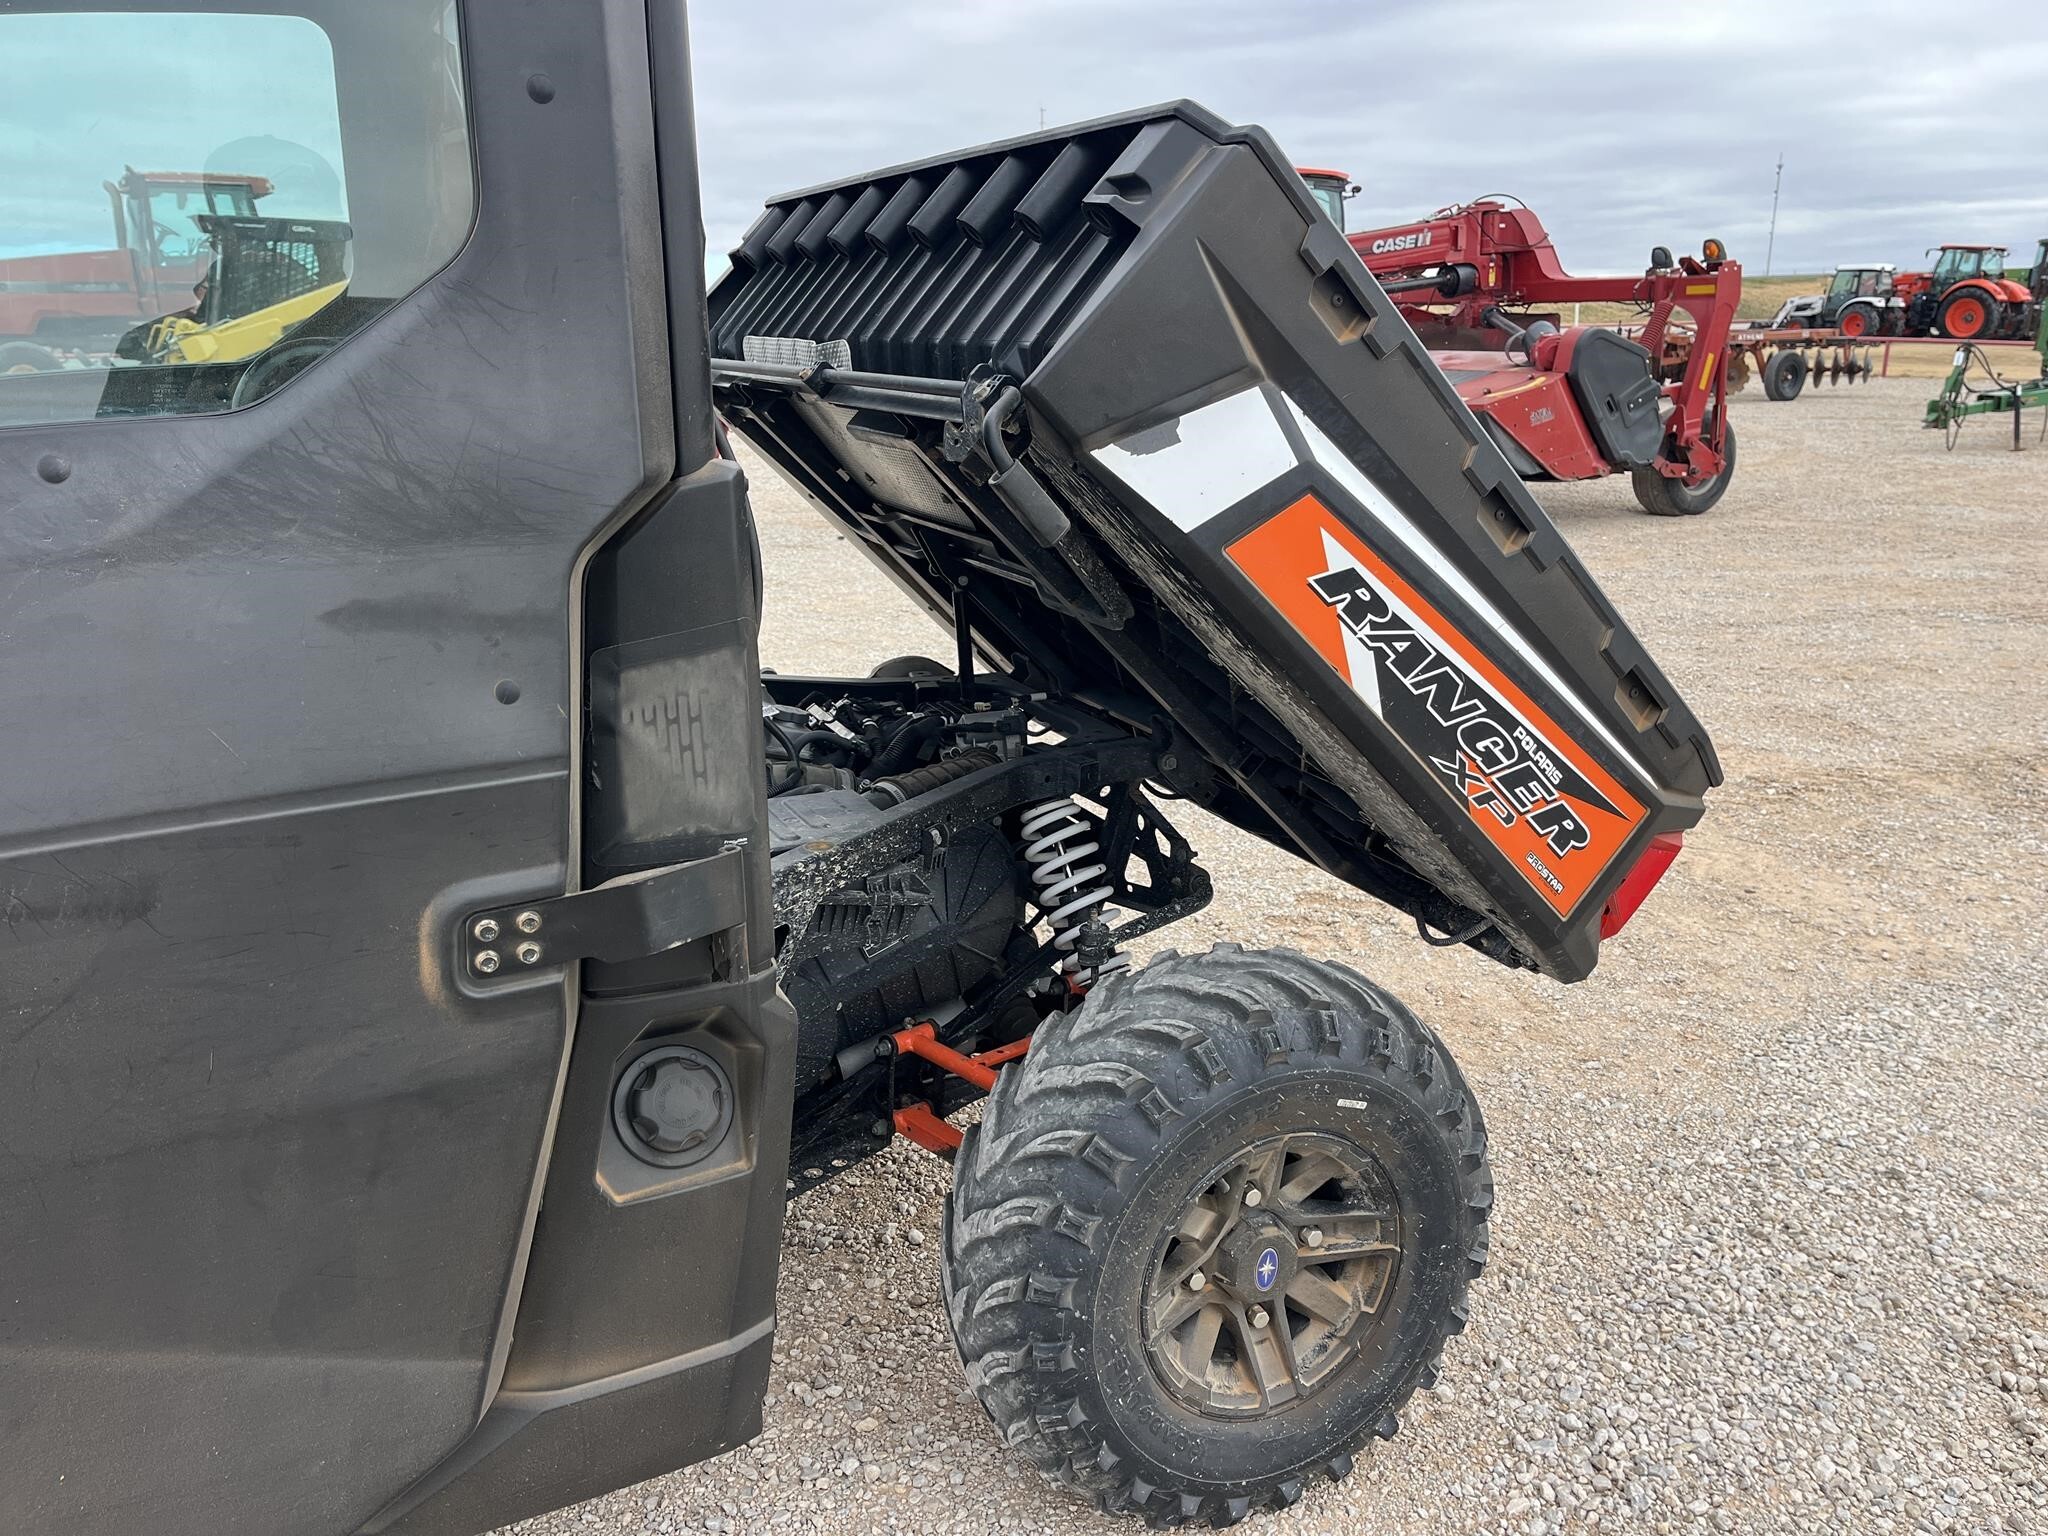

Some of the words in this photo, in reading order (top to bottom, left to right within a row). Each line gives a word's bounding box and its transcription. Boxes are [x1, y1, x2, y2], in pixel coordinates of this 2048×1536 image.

[1306, 566, 1591, 859] RANGER
[1428, 749, 1517, 828] XP
[1513, 726, 1563, 785] POLARIS
[1525, 850, 1565, 895] PROSTAR
